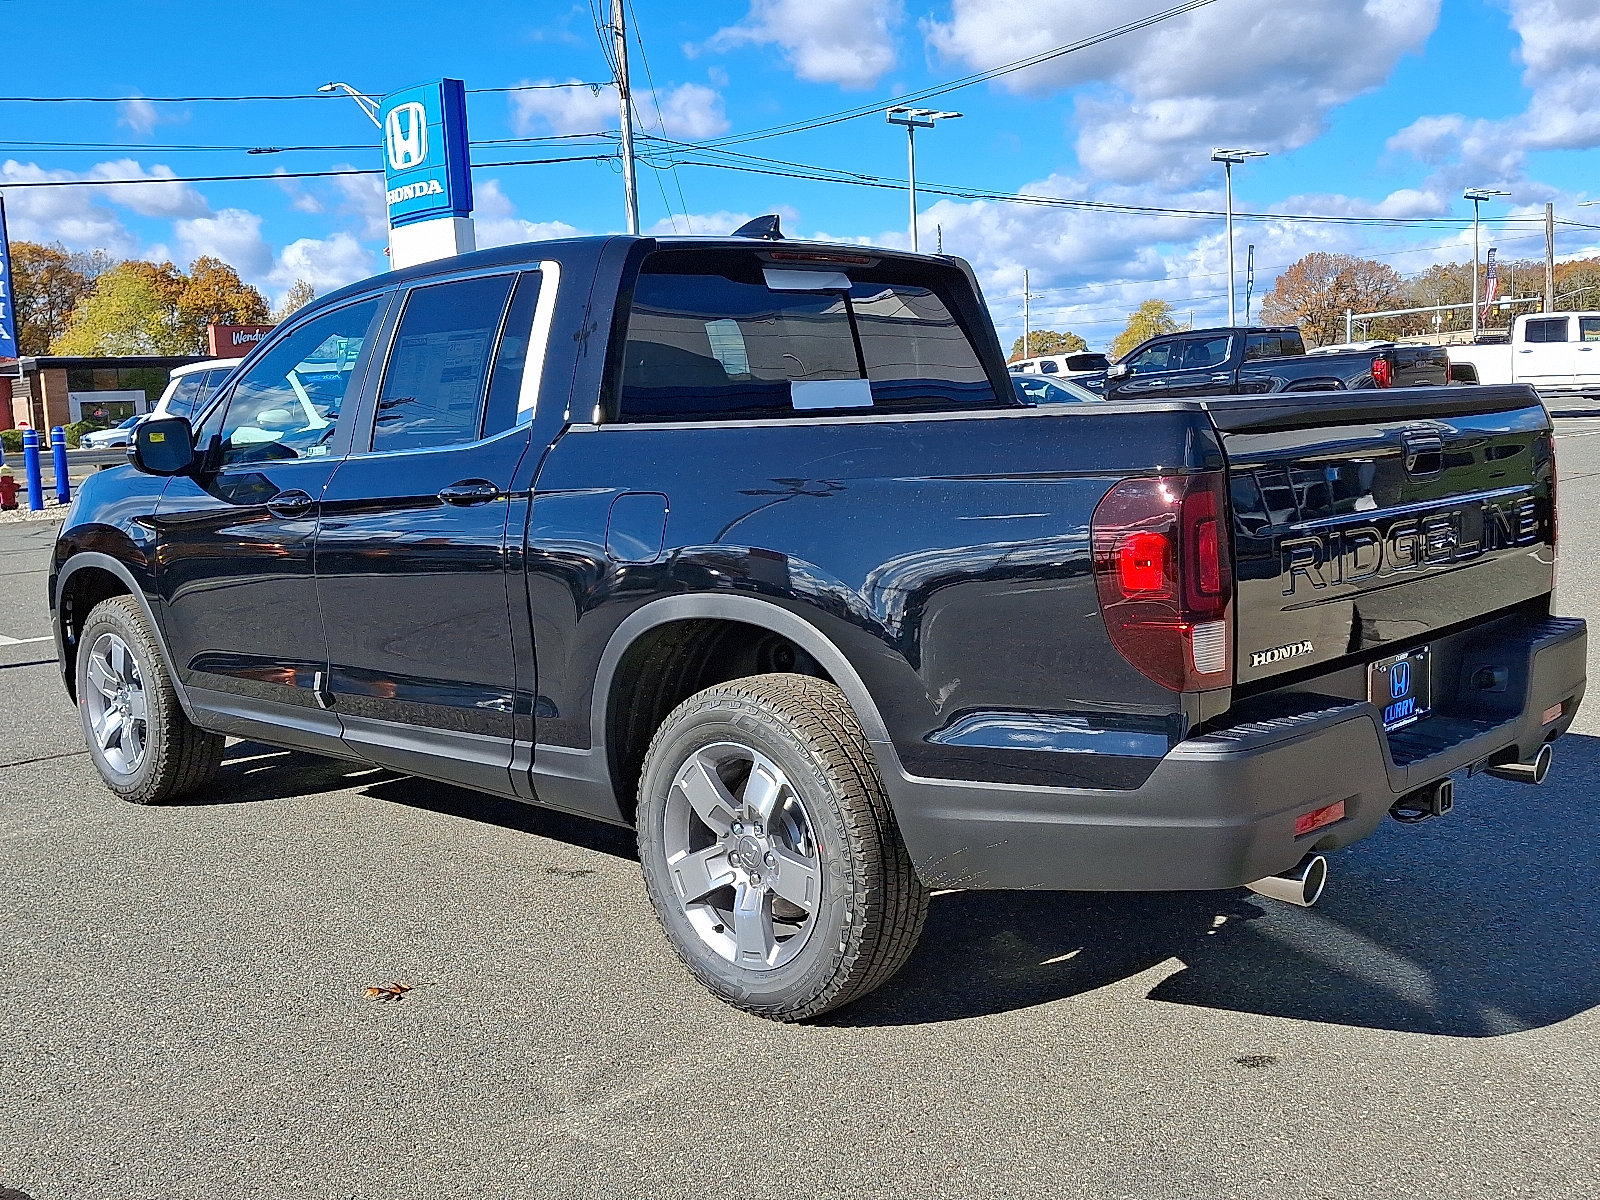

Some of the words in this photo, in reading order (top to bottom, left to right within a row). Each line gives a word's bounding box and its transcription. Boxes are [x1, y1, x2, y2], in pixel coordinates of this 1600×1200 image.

[386, 180, 444, 206] HONDA
[1280, 495, 1537, 597] RIDGELINE
[1250, 640, 1315, 668] HONDA
[1384, 697, 1416, 723] CURRY
